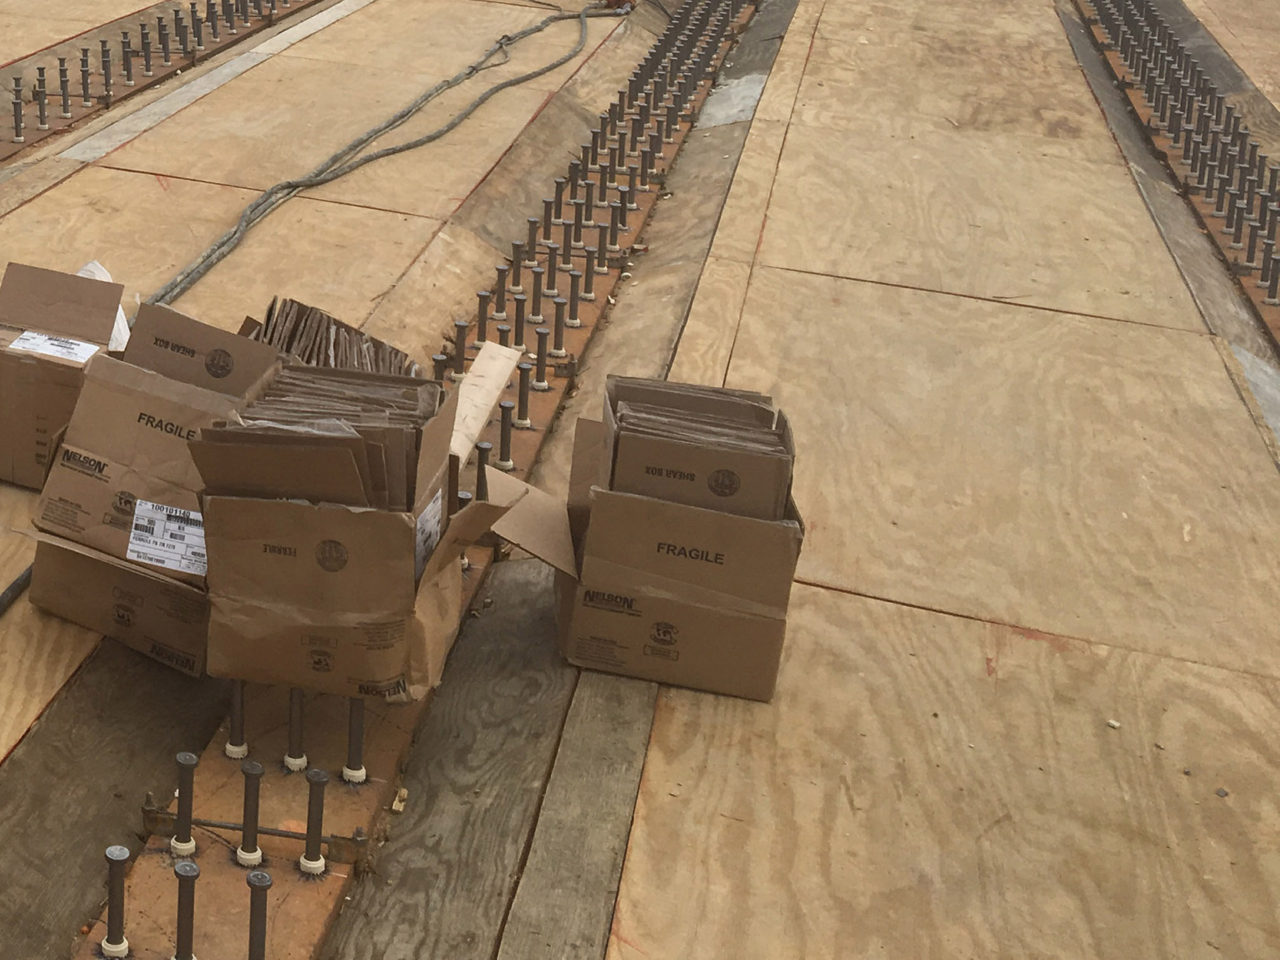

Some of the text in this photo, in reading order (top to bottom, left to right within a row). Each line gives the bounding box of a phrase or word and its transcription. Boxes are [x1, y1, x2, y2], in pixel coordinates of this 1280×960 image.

[153, 337, 196, 358] SHEAR BOX
[137, 412, 197, 440] FRAGILE
[62, 449, 107, 473] NELSON
[645, 465, 696, 482] SHEAR BOX
[656, 542, 725, 565] FRAGILE
[583, 590, 635, 609] NELSON
[358, 678, 409, 697] NELSON
